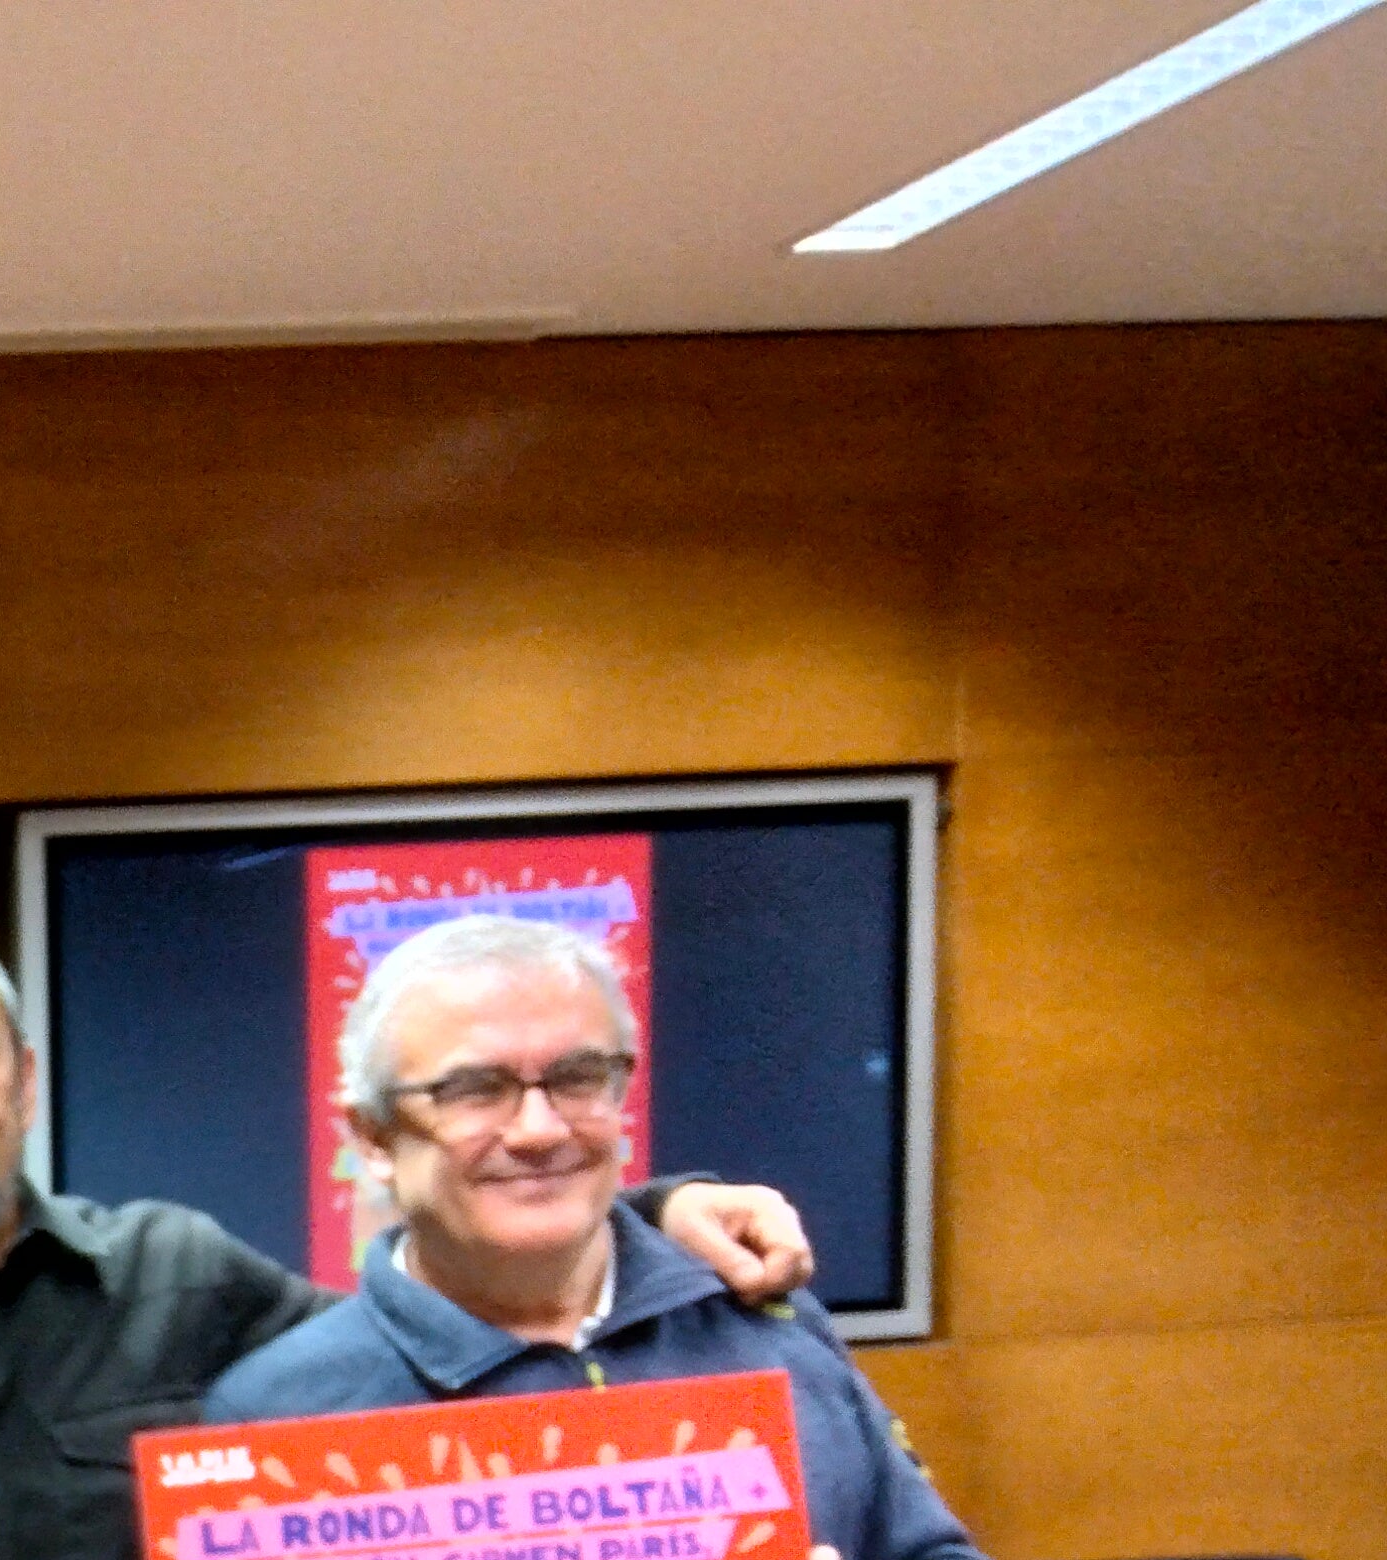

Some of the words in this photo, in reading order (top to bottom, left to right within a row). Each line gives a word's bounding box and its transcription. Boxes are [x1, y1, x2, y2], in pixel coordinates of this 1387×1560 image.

[201, 1518, 261, 1555] LA
[281, 1503, 431, 1548] RONDA
[452, 1493, 508, 1532] DE
[530, 1464, 731, 1525] BOLTAÑA
